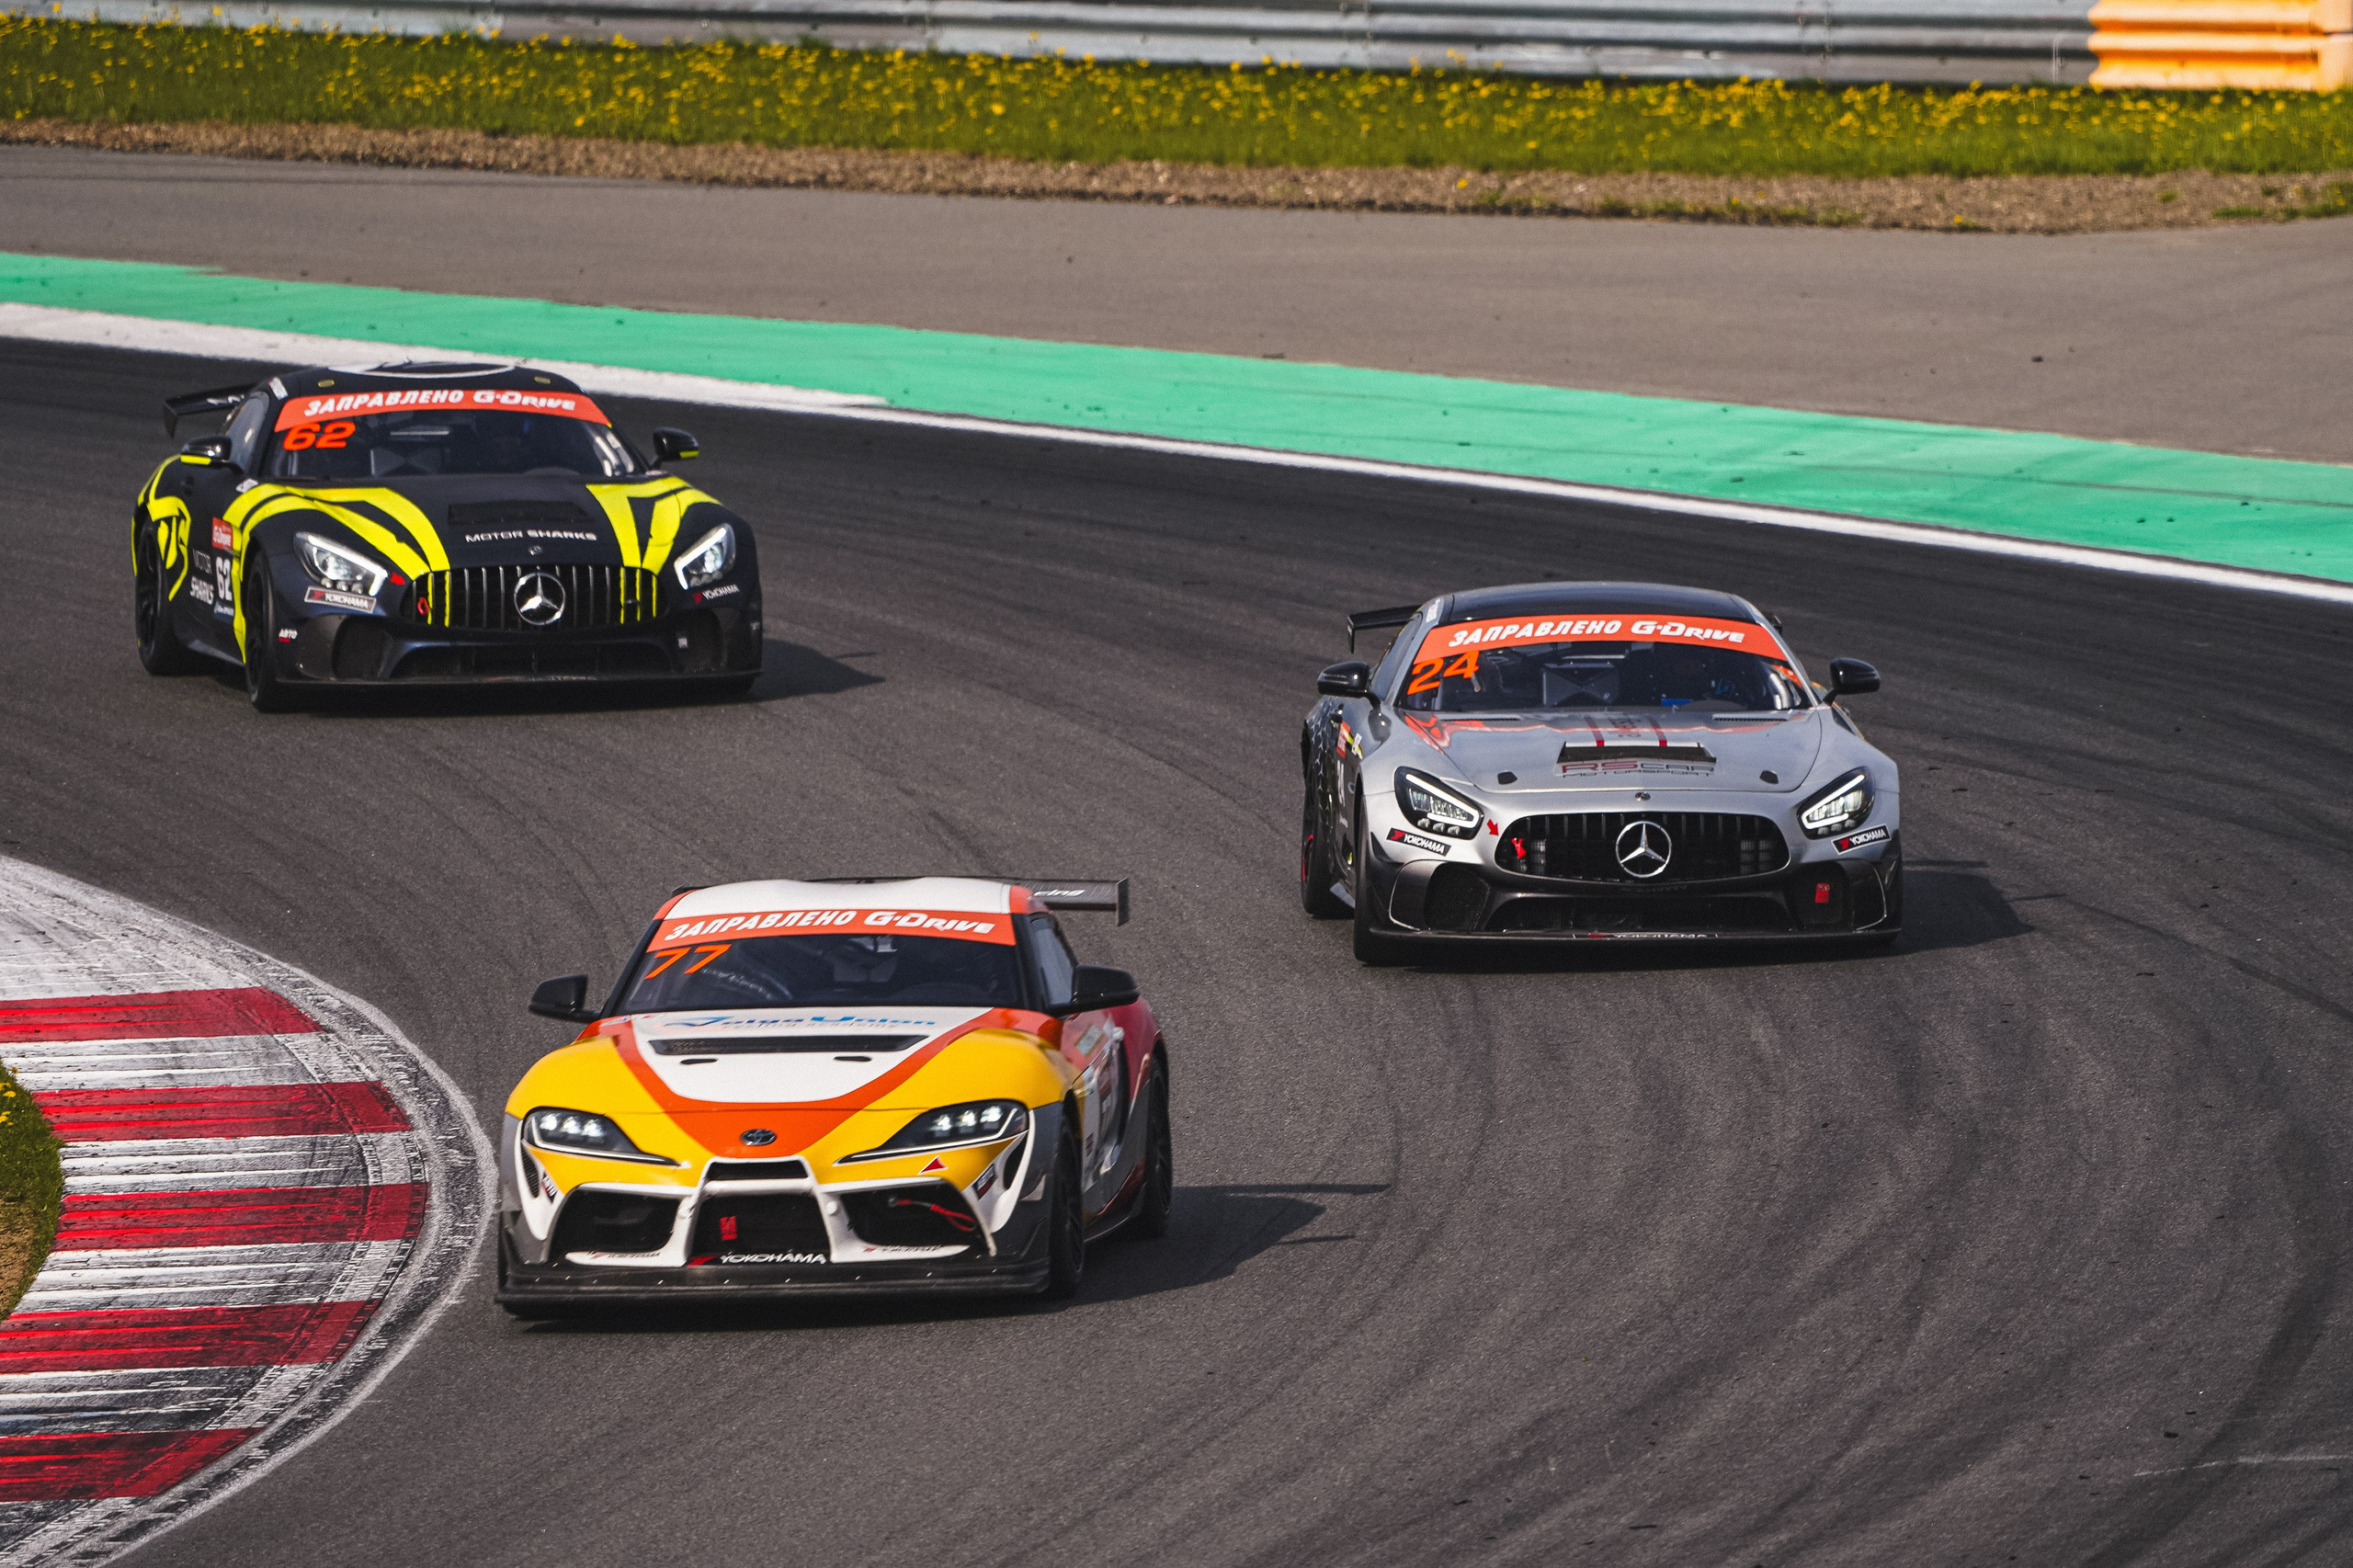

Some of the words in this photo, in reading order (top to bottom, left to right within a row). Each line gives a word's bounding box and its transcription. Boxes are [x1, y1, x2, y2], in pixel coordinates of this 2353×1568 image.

[304, 390, 464, 417] ЗАПРАВЛЕНО
[283, 421, 356, 450] 62
[465, 530, 523, 543] MOTOR
[527, 529, 597, 541] SHARKS
[216, 556, 233, 601] 62
[701, 584, 740, 600] YOKOHAMA
[1449, 620, 1621, 647] ЗАПРАВЛЕНО
[1406, 650, 1480, 696] 24
[1404, 834, 1445, 855] YOKOHAMA
[1849, 828, 1887, 846] YOKOHAMA
[664, 911, 858, 941] ЗАПРАВЛЕНО
[643, 943, 732, 981] 77
[721, 1252, 827, 1265] YOKOHAMA
